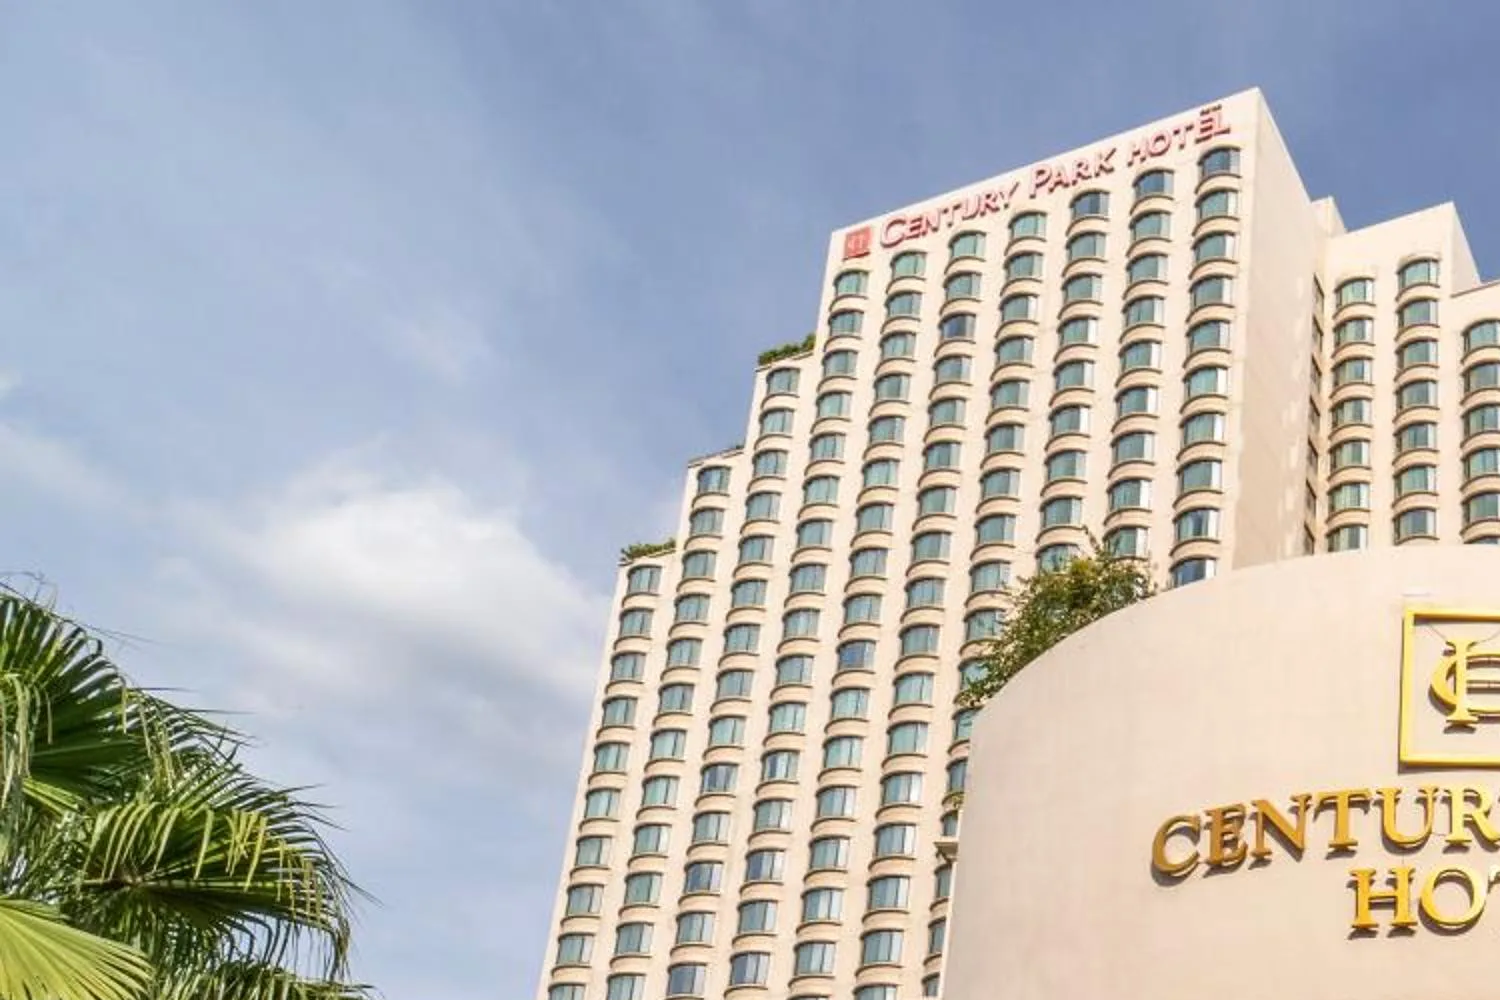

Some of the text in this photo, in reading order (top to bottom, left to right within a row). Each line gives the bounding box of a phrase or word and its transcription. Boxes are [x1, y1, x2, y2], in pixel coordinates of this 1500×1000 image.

[880, 180, 1020, 249] CENTURY
[1028, 147, 1118, 199] PARK
[1126, 104, 1232, 167] HOTEL
